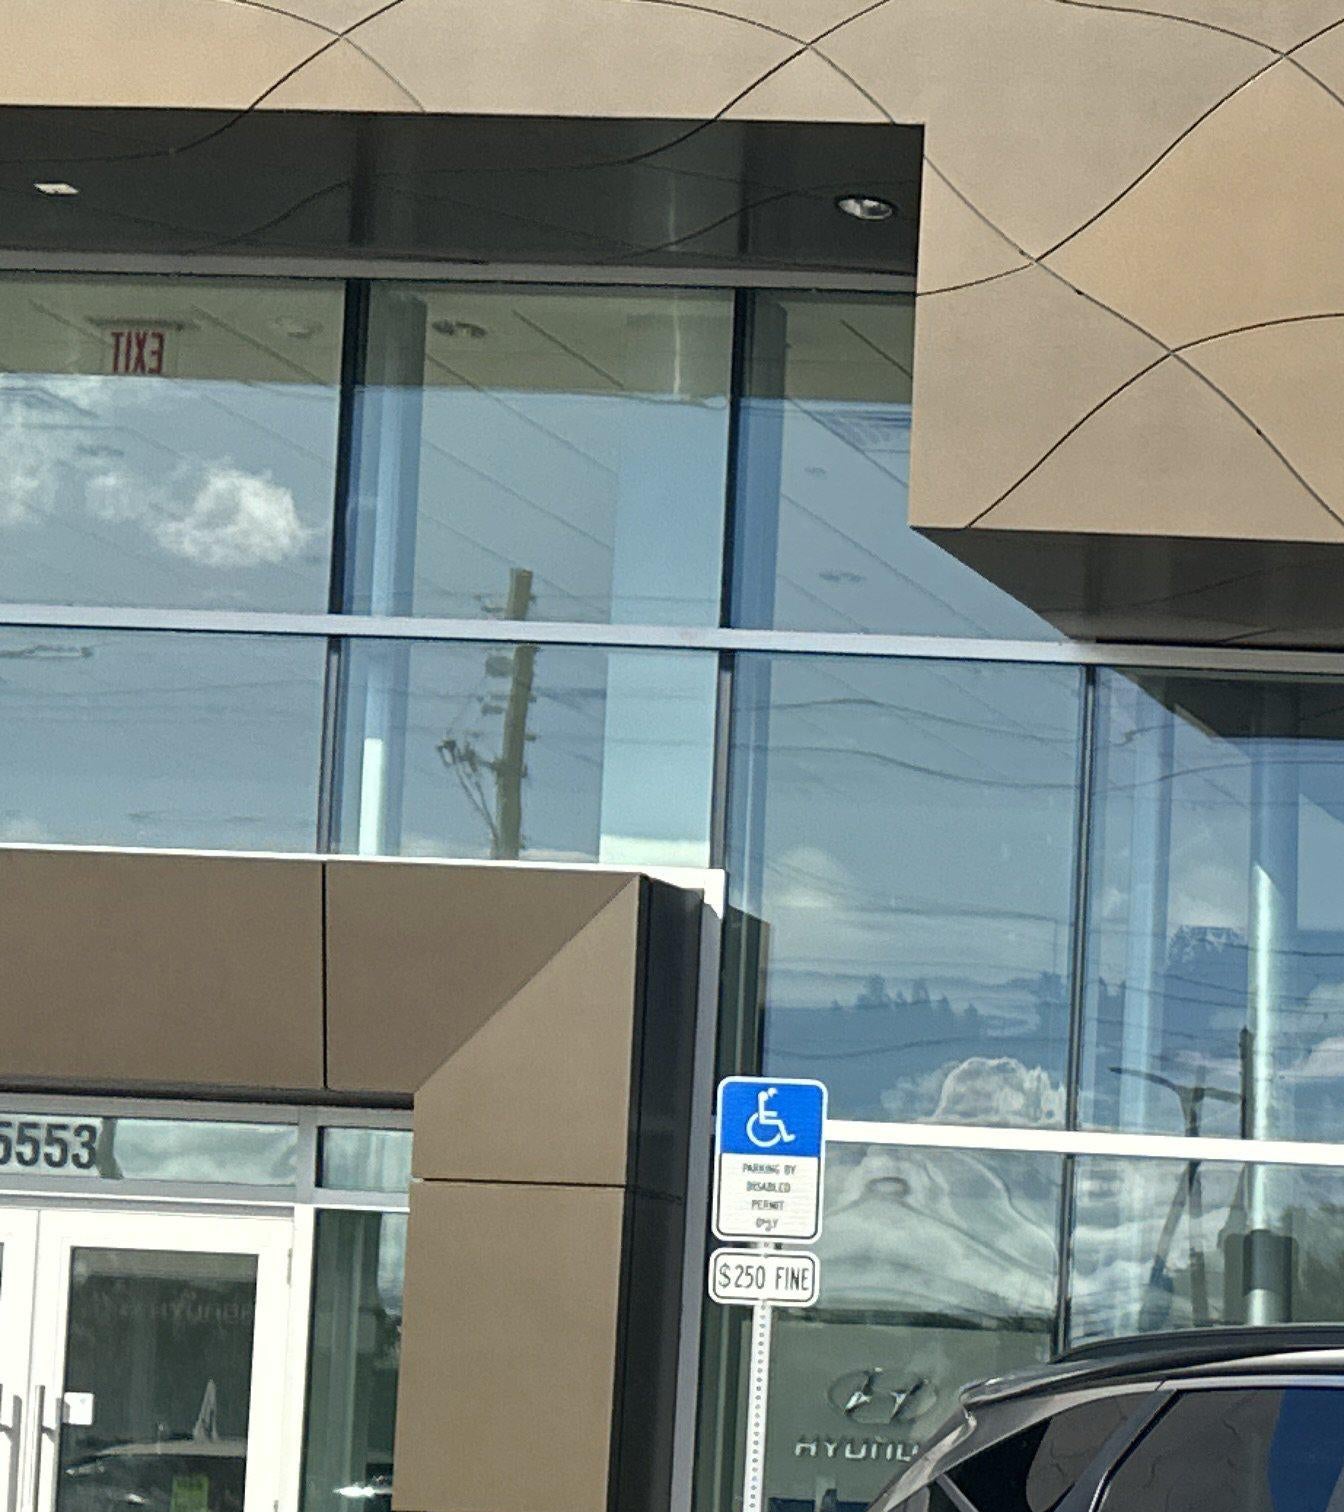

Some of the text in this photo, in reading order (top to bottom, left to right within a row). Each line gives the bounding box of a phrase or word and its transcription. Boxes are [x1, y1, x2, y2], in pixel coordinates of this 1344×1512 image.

[743, 1163, 780, 1175] PARKING
[718, 1262, 810, 1291] $250 FINE
